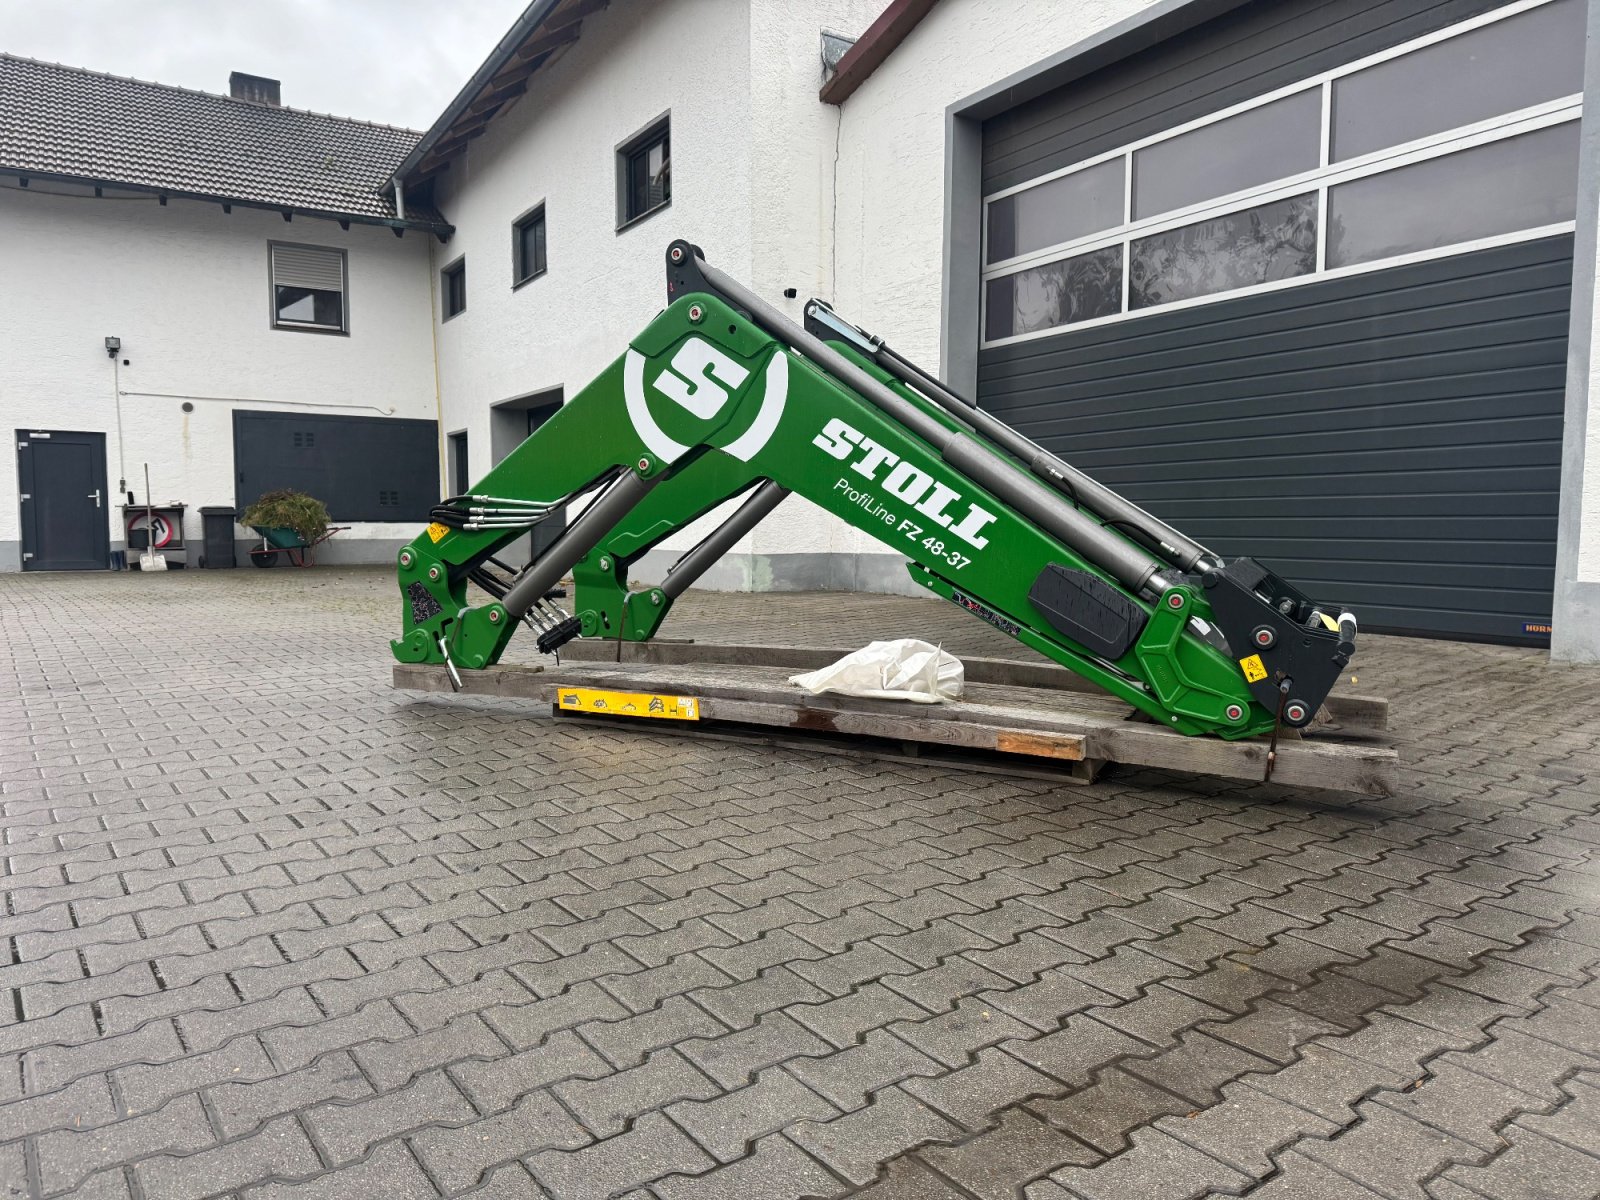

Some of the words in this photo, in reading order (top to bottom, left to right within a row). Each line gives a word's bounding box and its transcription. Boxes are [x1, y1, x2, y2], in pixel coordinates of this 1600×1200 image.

[652, 337, 751, 420] S
[812, 417, 998, 550] STOLL
[833, 478, 896, 525] ProfiLine
[896, 519, 924, 541] FZ
[922, 537, 972, 570] 48-37
